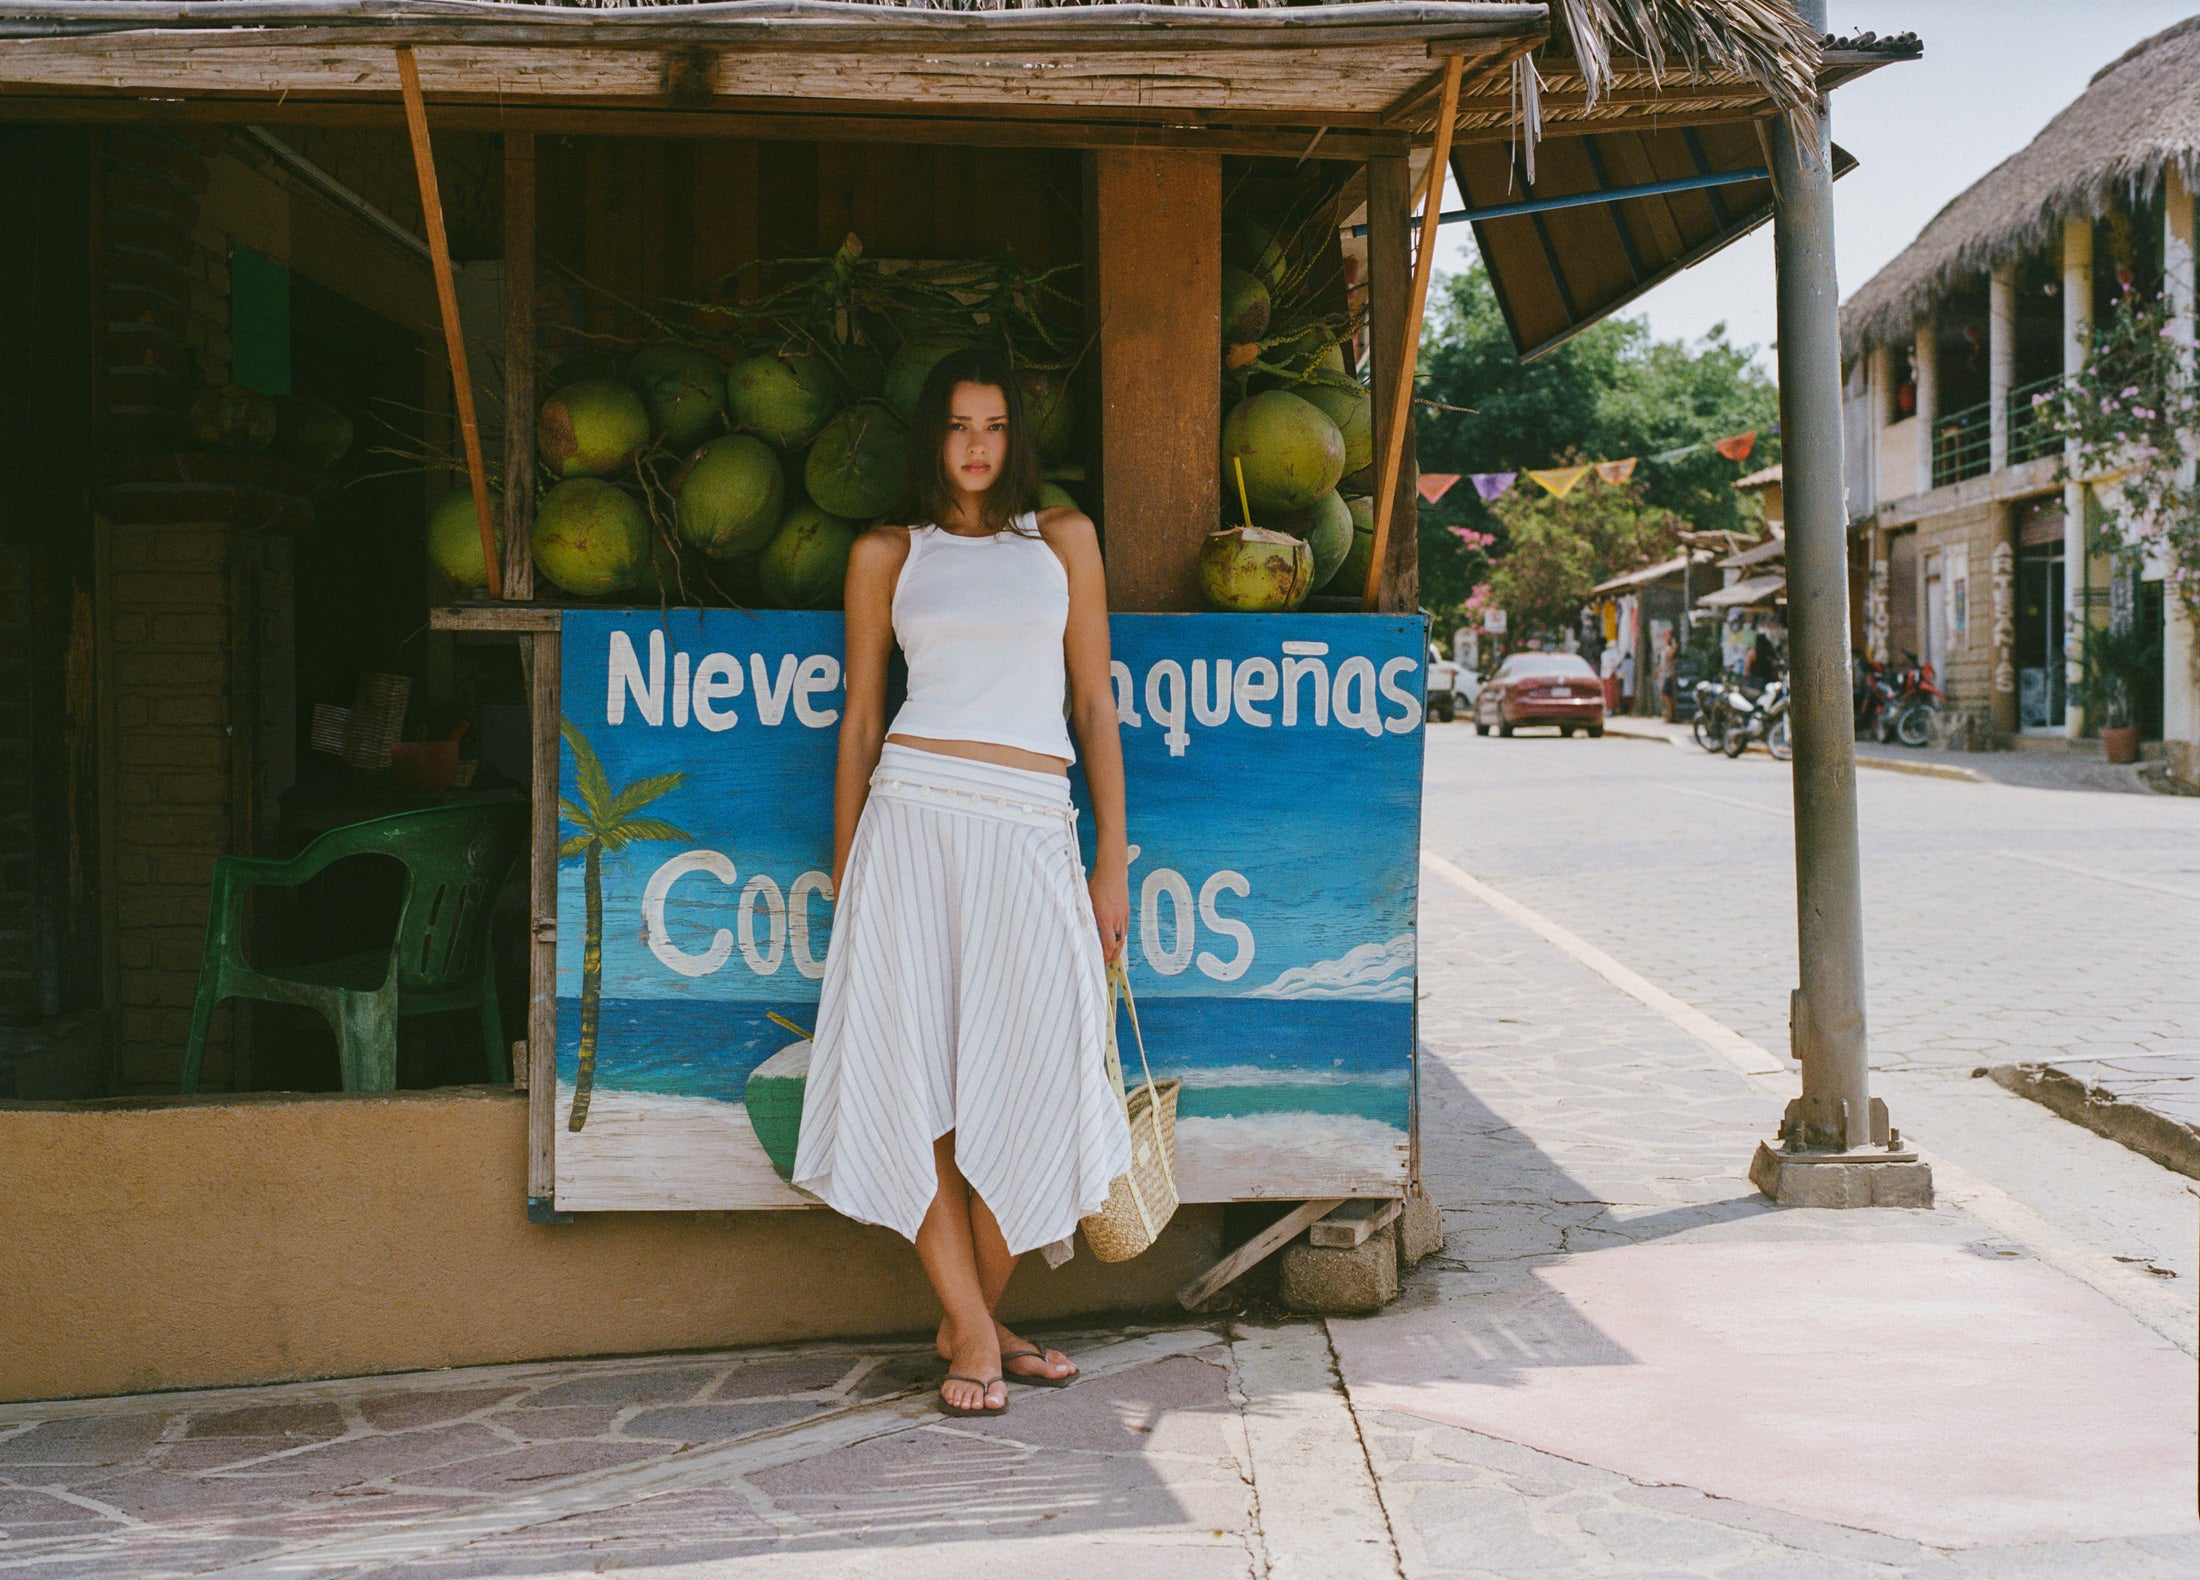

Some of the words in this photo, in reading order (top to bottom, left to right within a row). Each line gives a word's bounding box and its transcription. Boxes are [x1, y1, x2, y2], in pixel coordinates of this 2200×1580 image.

[607, 629, 847, 732] Nieve
[1109, 641, 1422, 757] aqueñas
[642, 850, 835, 978] Coc
